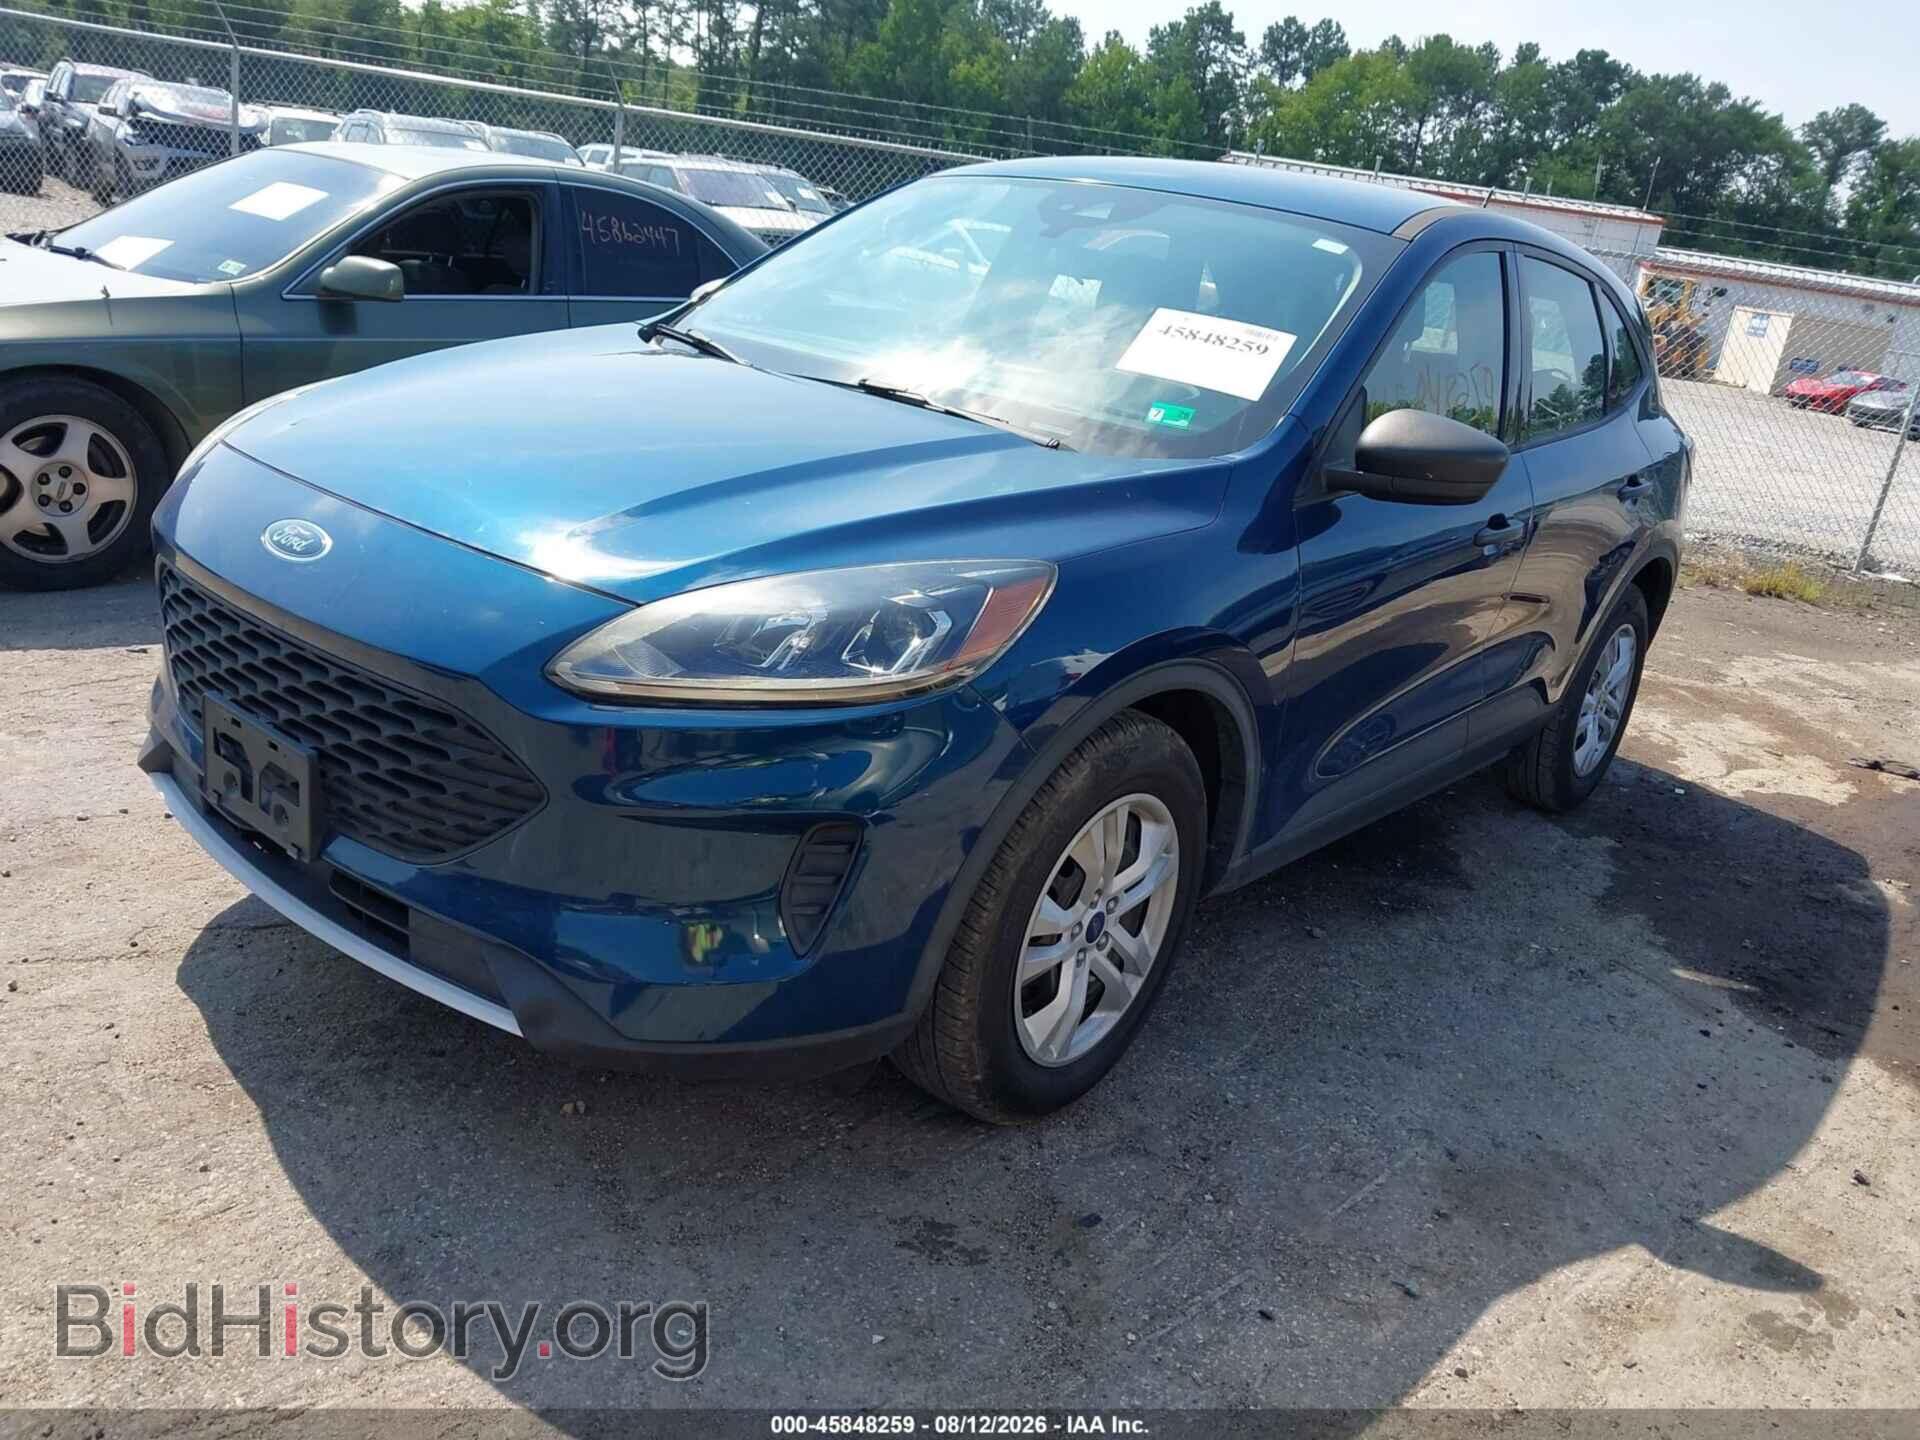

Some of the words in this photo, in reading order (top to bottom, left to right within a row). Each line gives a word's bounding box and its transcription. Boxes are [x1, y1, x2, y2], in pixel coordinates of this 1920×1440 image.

[582, 209, 680, 256] 45862447
[1158, 324, 1270, 355] 45848259
[273, 526, 314, 551] Ford
